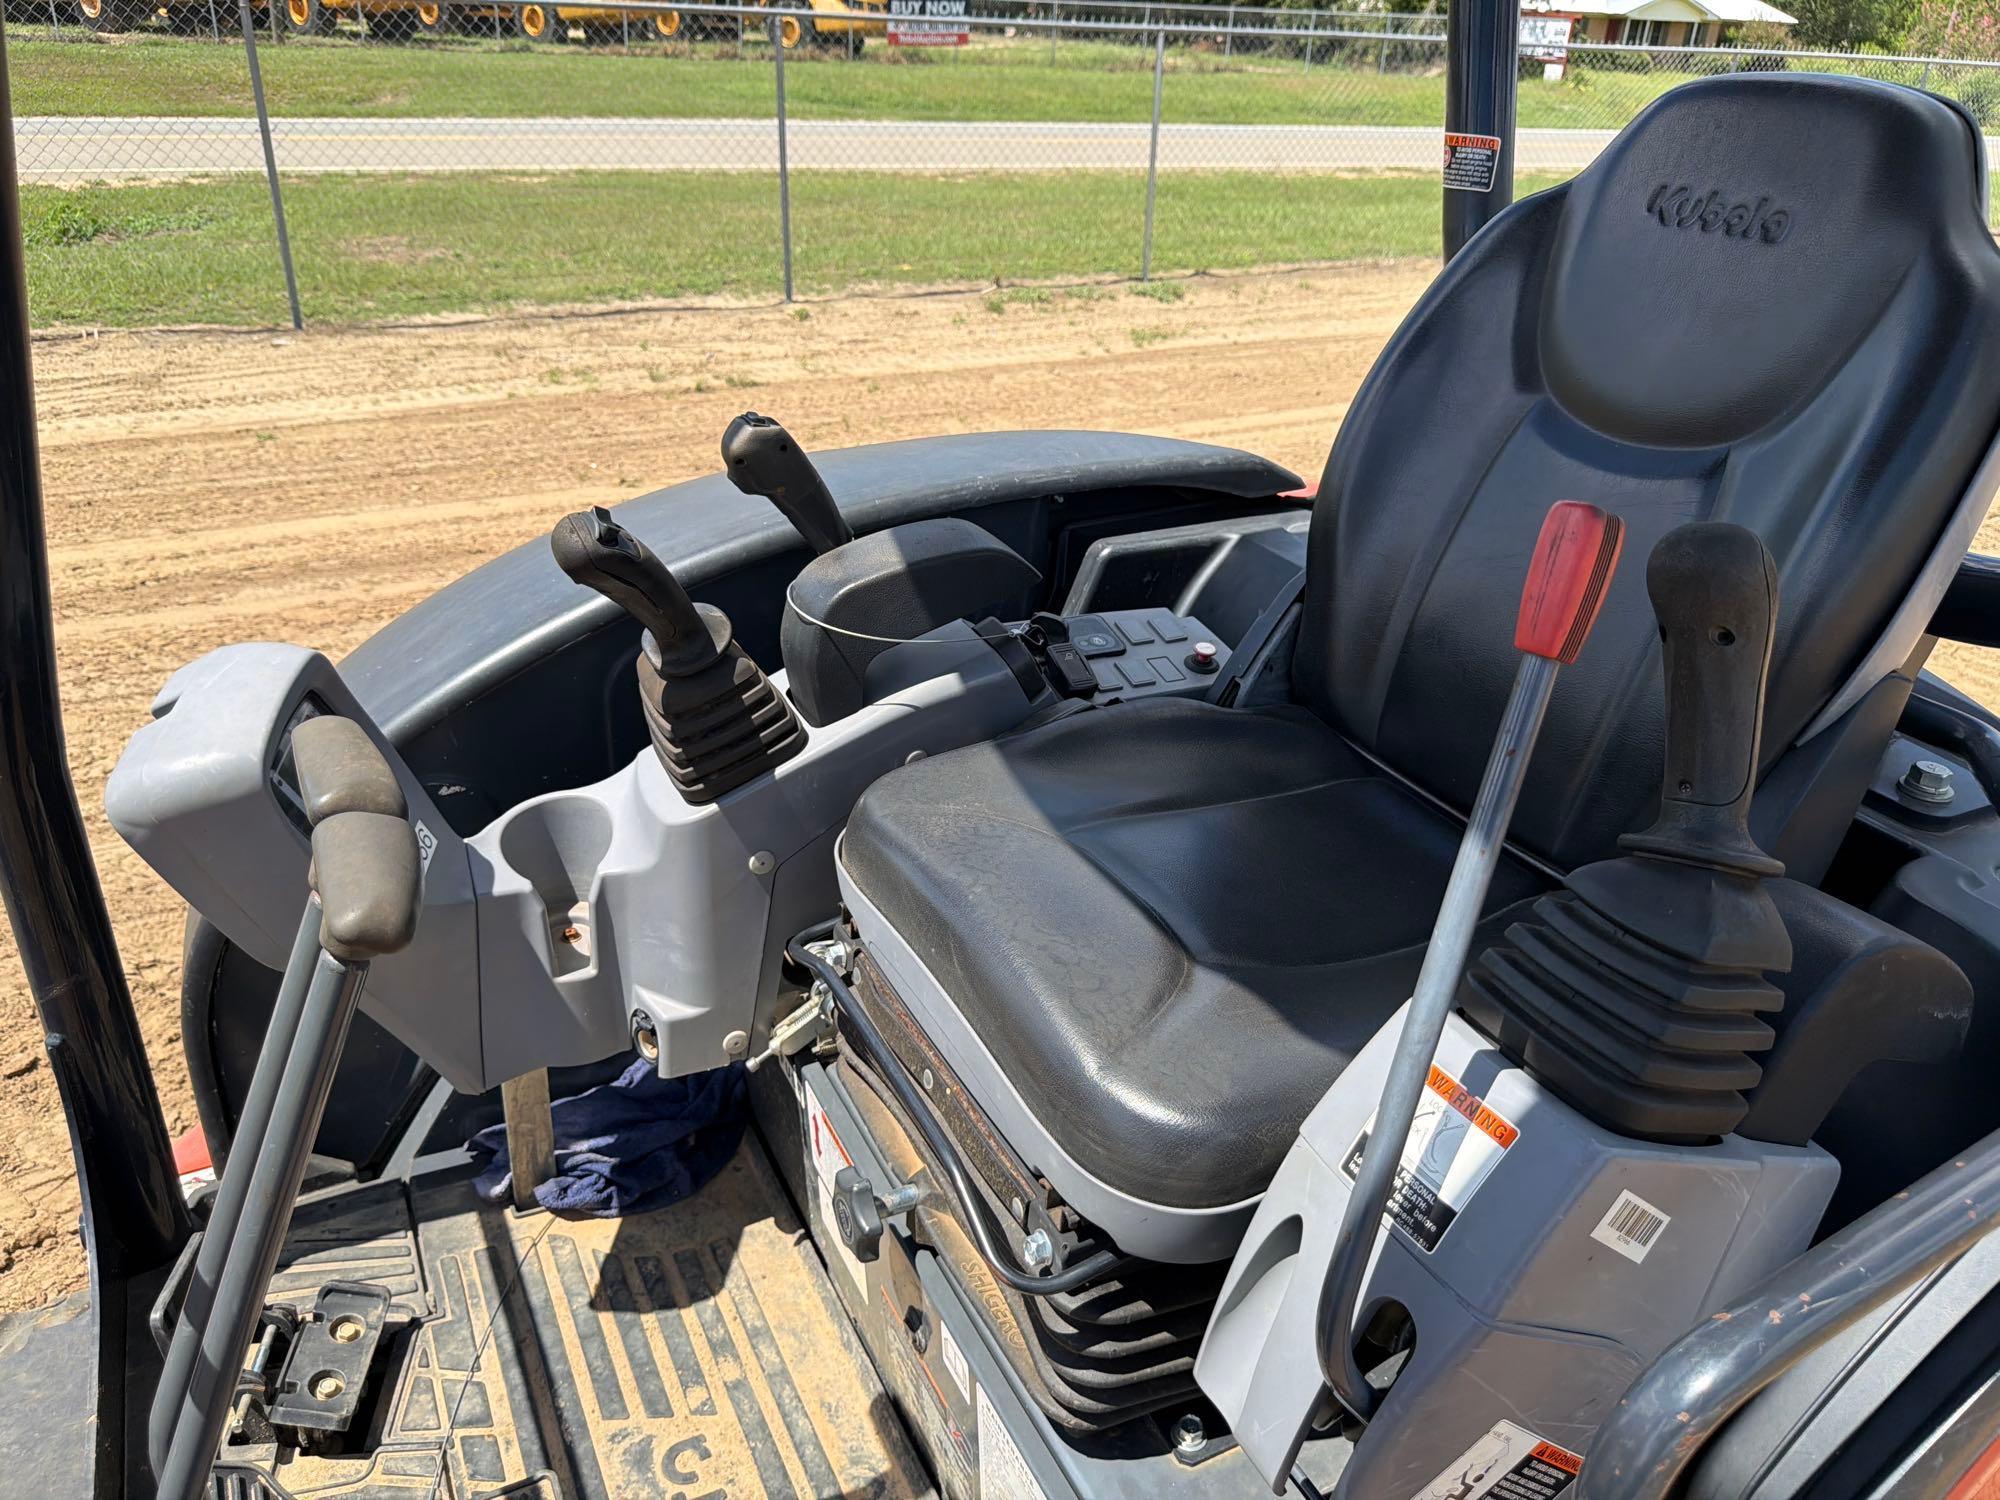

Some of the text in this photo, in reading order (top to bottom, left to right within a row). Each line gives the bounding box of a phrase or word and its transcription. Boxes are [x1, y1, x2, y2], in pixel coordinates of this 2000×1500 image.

[890, 1, 966, 17] BUY NOW
[1445, 135, 1497, 149] WARNING
[1432, 1073, 1508, 1141] WARNING
[1400, 1169, 1436, 1205] PERSONAL
[1401, 1185, 1428, 1212] DEATH:
[1392, 1190, 1412, 1210] lever
[1413, 1208, 1437, 1232] before
